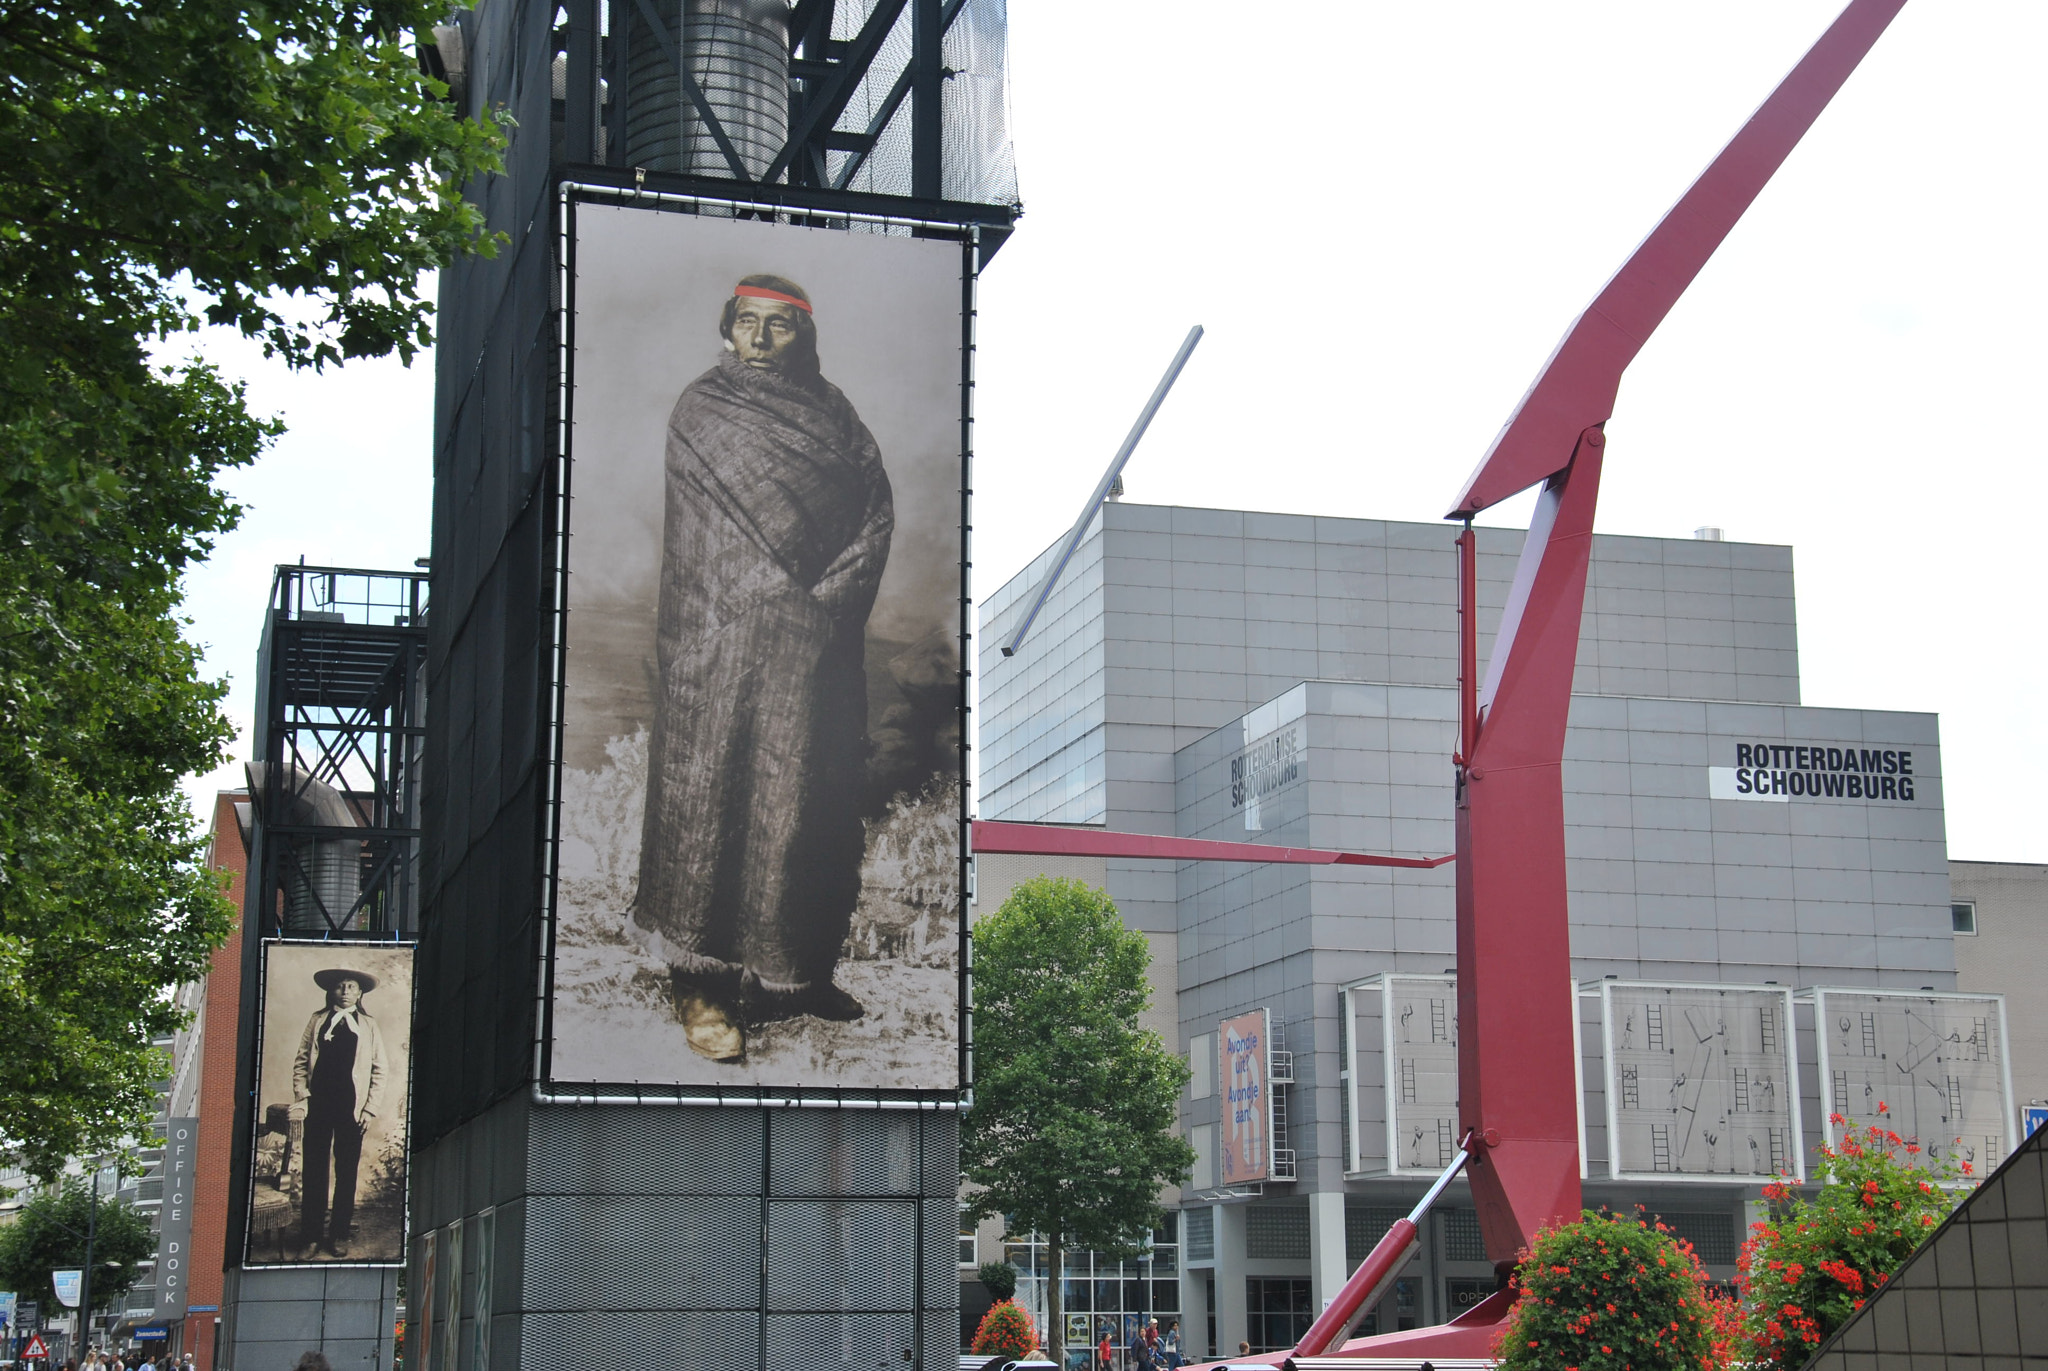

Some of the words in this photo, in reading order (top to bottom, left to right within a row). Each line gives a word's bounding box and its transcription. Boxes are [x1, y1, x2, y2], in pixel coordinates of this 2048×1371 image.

[1231, 728, 1297, 783] ROTTERDAMSE
[1736, 743, 1913, 775] ROTTERDAMSE
[1232, 755, 1298, 808] SCHOUWBURG
[1736, 768, 1914, 801] SCHOUWBURG
[1227, 1031, 1258, 1055] Avondje
[1235, 1054, 1250, 1074] uit?
[1228, 1081, 1259, 1104] Avondje
[171, 1128, 188, 1221] OFFICE
[165, 1242, 180, 1304] DOCK
[1458, 1292, 1490, 1303] OPE
